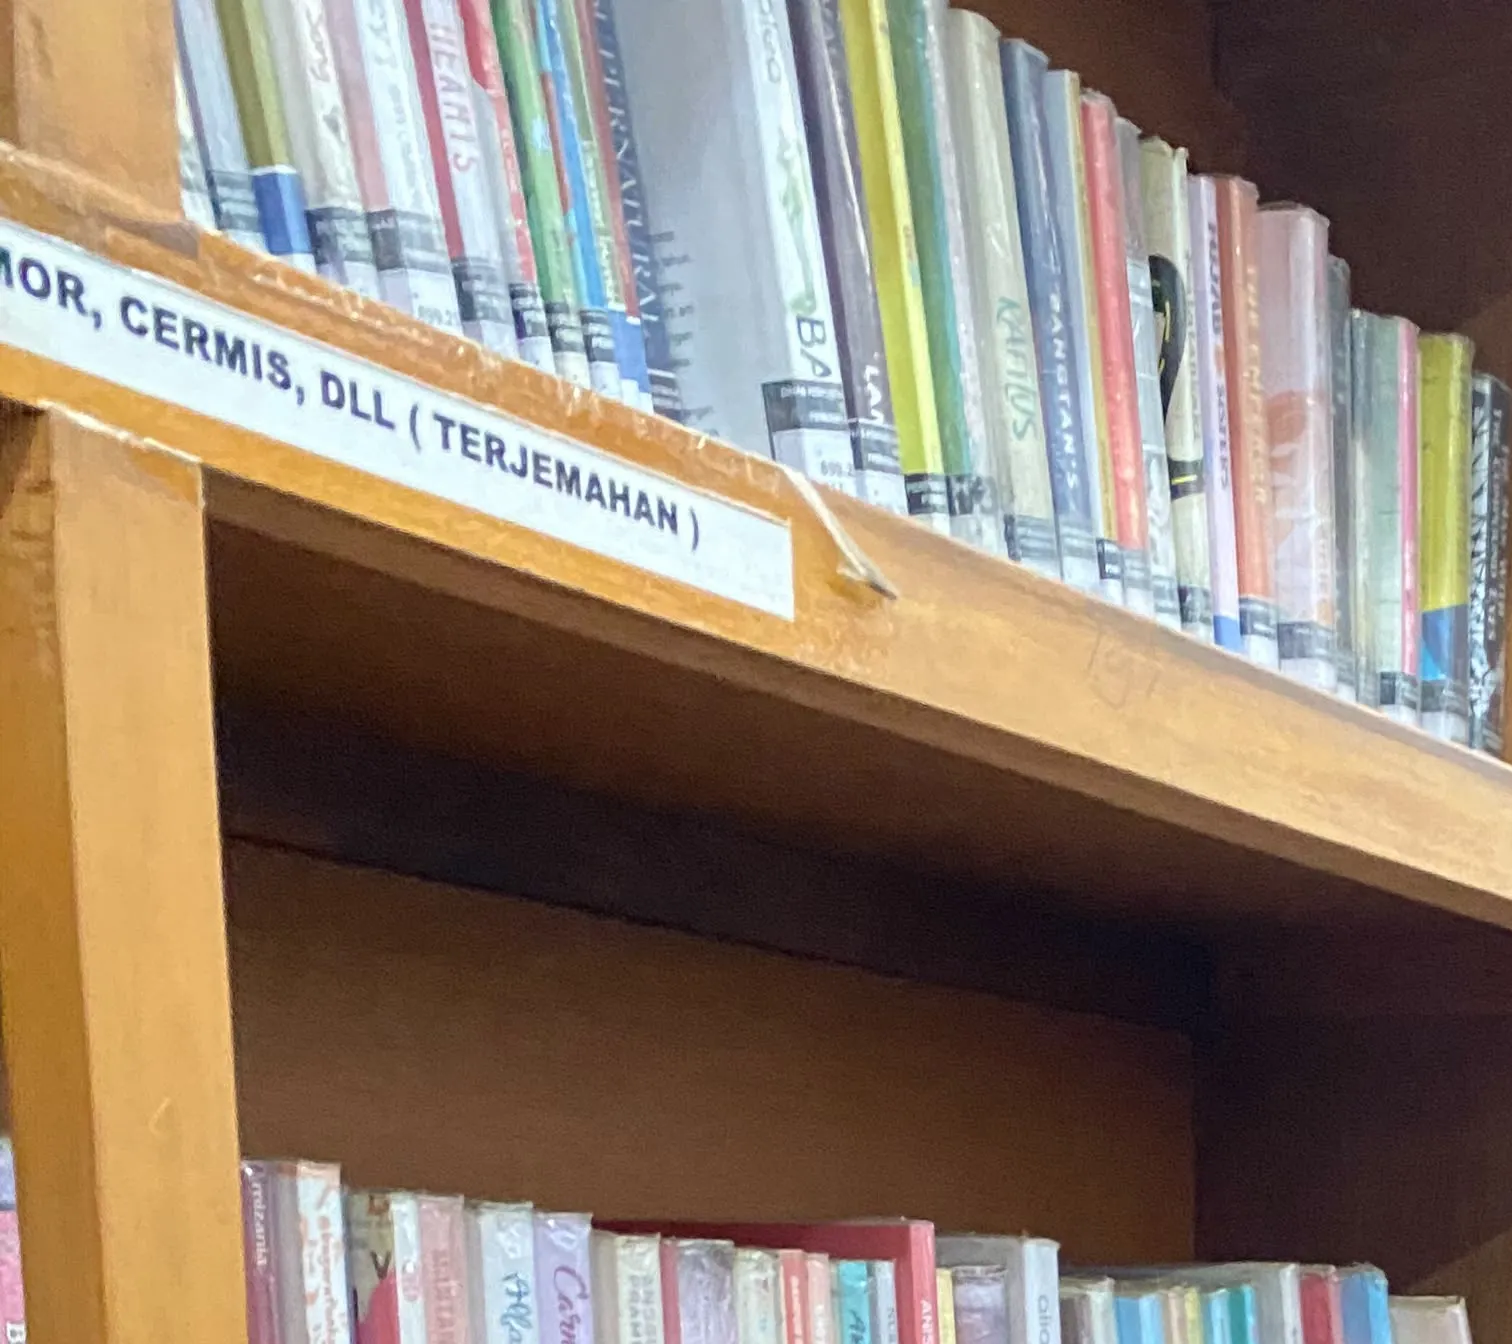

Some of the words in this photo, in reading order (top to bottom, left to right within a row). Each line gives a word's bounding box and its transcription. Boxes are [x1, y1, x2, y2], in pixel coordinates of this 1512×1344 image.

[119, 295, 304, 406] CERMIS,
[320, 369, 395, 431] DLL
[433, 412, 679, 536] TERJEMAHAN
